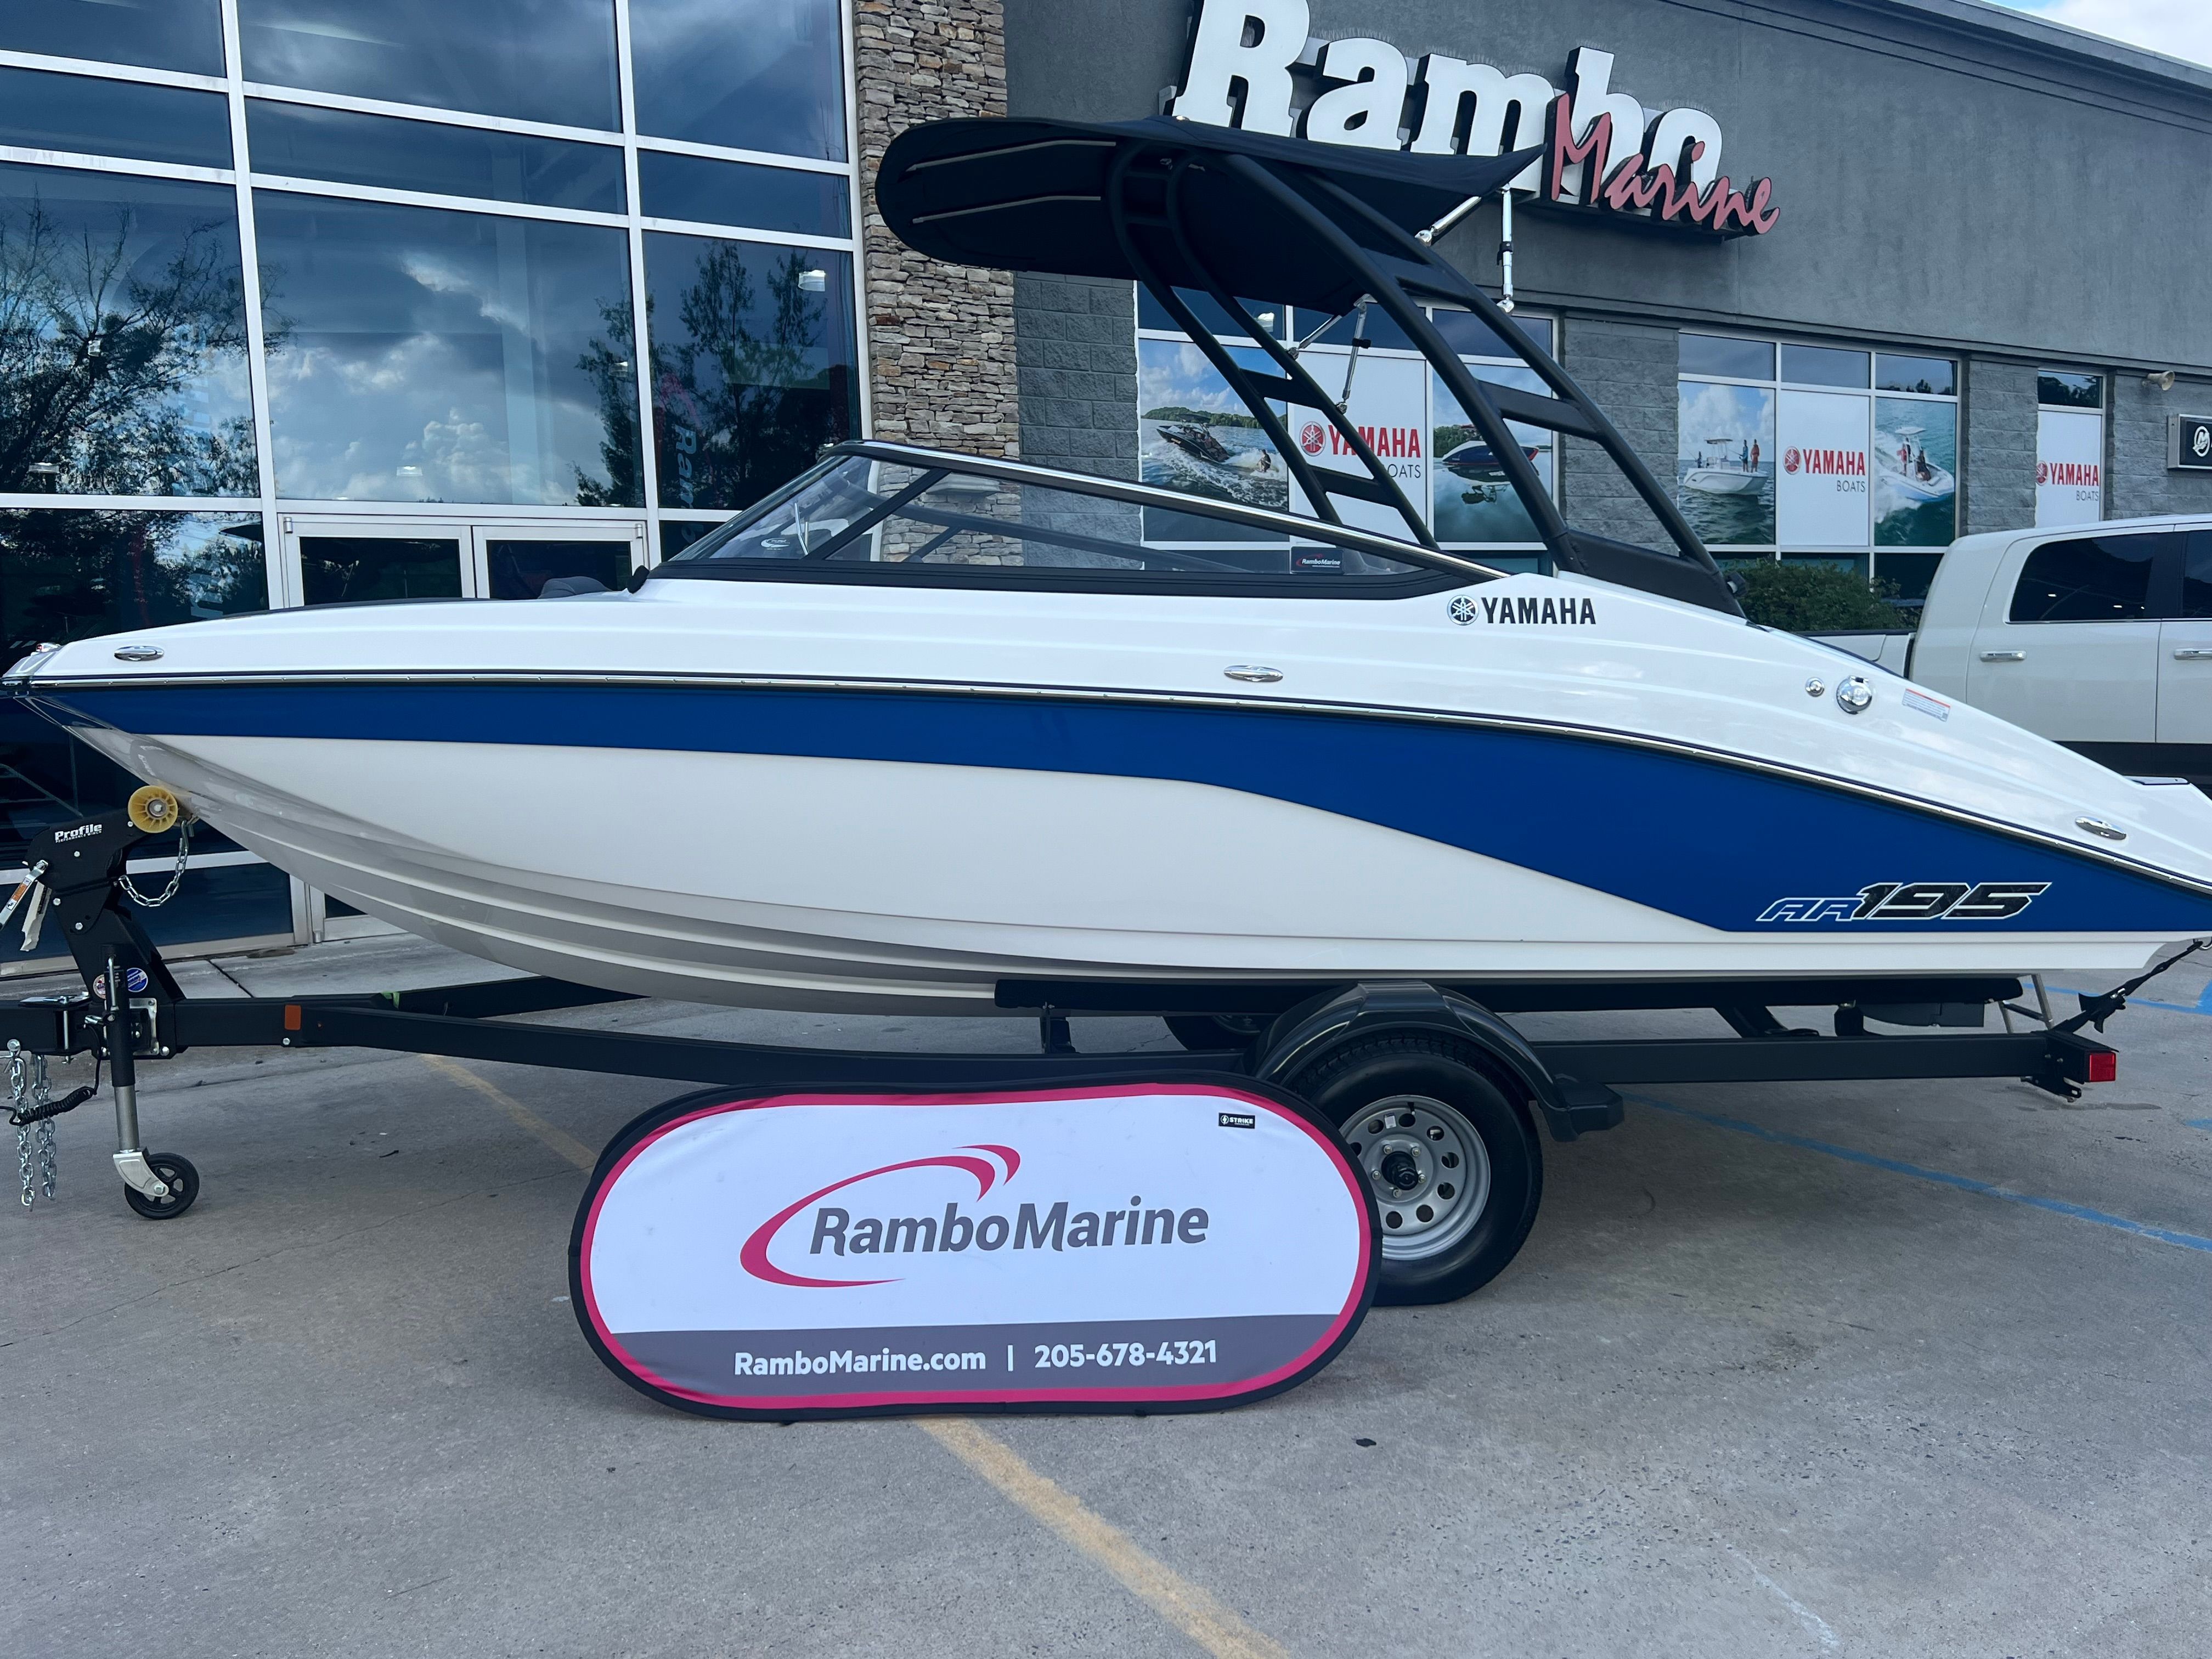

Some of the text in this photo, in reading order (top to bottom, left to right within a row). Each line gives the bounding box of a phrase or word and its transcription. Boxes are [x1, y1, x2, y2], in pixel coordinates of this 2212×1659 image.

[1169, 0, 1723, 194] Rambo
[1550, 93, 1780, 235] Marine
[1383, 464, 1421, 478] OATS
[1803, 449, 1865, 476] YAMAHA
[2050, 462, 2099, 487] YAMAHA
[673, 424, 704, 549] Ramb
[1837, 480, 1865, 493] BOATS
[2075, 490, 2098, 501] BOATS
[1481, 597, 1596, 624] YAMAHA
[55, 823, 102, 841] Profile
[809, 1195, 1209, 1256] RamboMarine
[734, 1347, 986, 1375] RamboMarine.com
[1034, 1340, 1217, 1368] 205-678-4321
